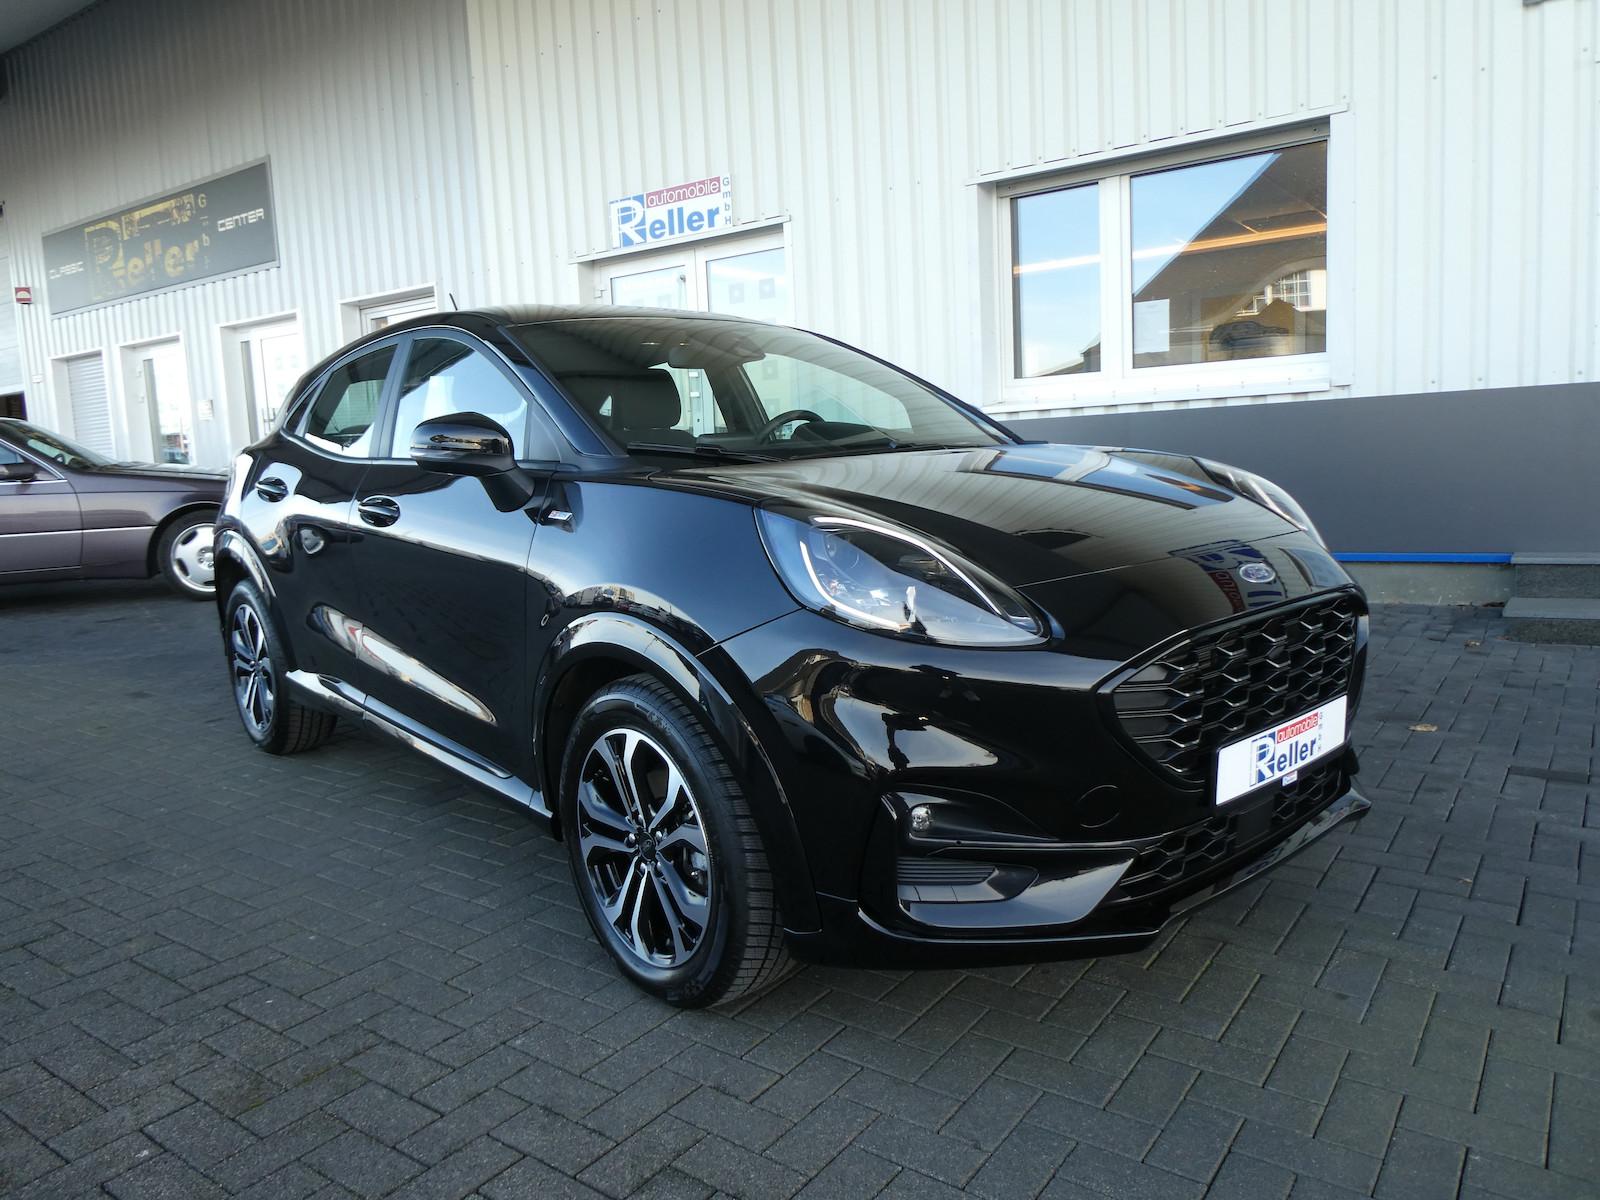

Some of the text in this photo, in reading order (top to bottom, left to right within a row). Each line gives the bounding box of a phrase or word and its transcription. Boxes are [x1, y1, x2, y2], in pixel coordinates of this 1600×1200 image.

[647, 180, 720, 207] automobile
[721, 176, 732, 225] GmbH
[216, 207, 265, 232] CENTER
[609, 194, 720, 249] Reller
[1277, 714, 1319, 743] automobile
[1249, 731, 1317, 787] Reller
